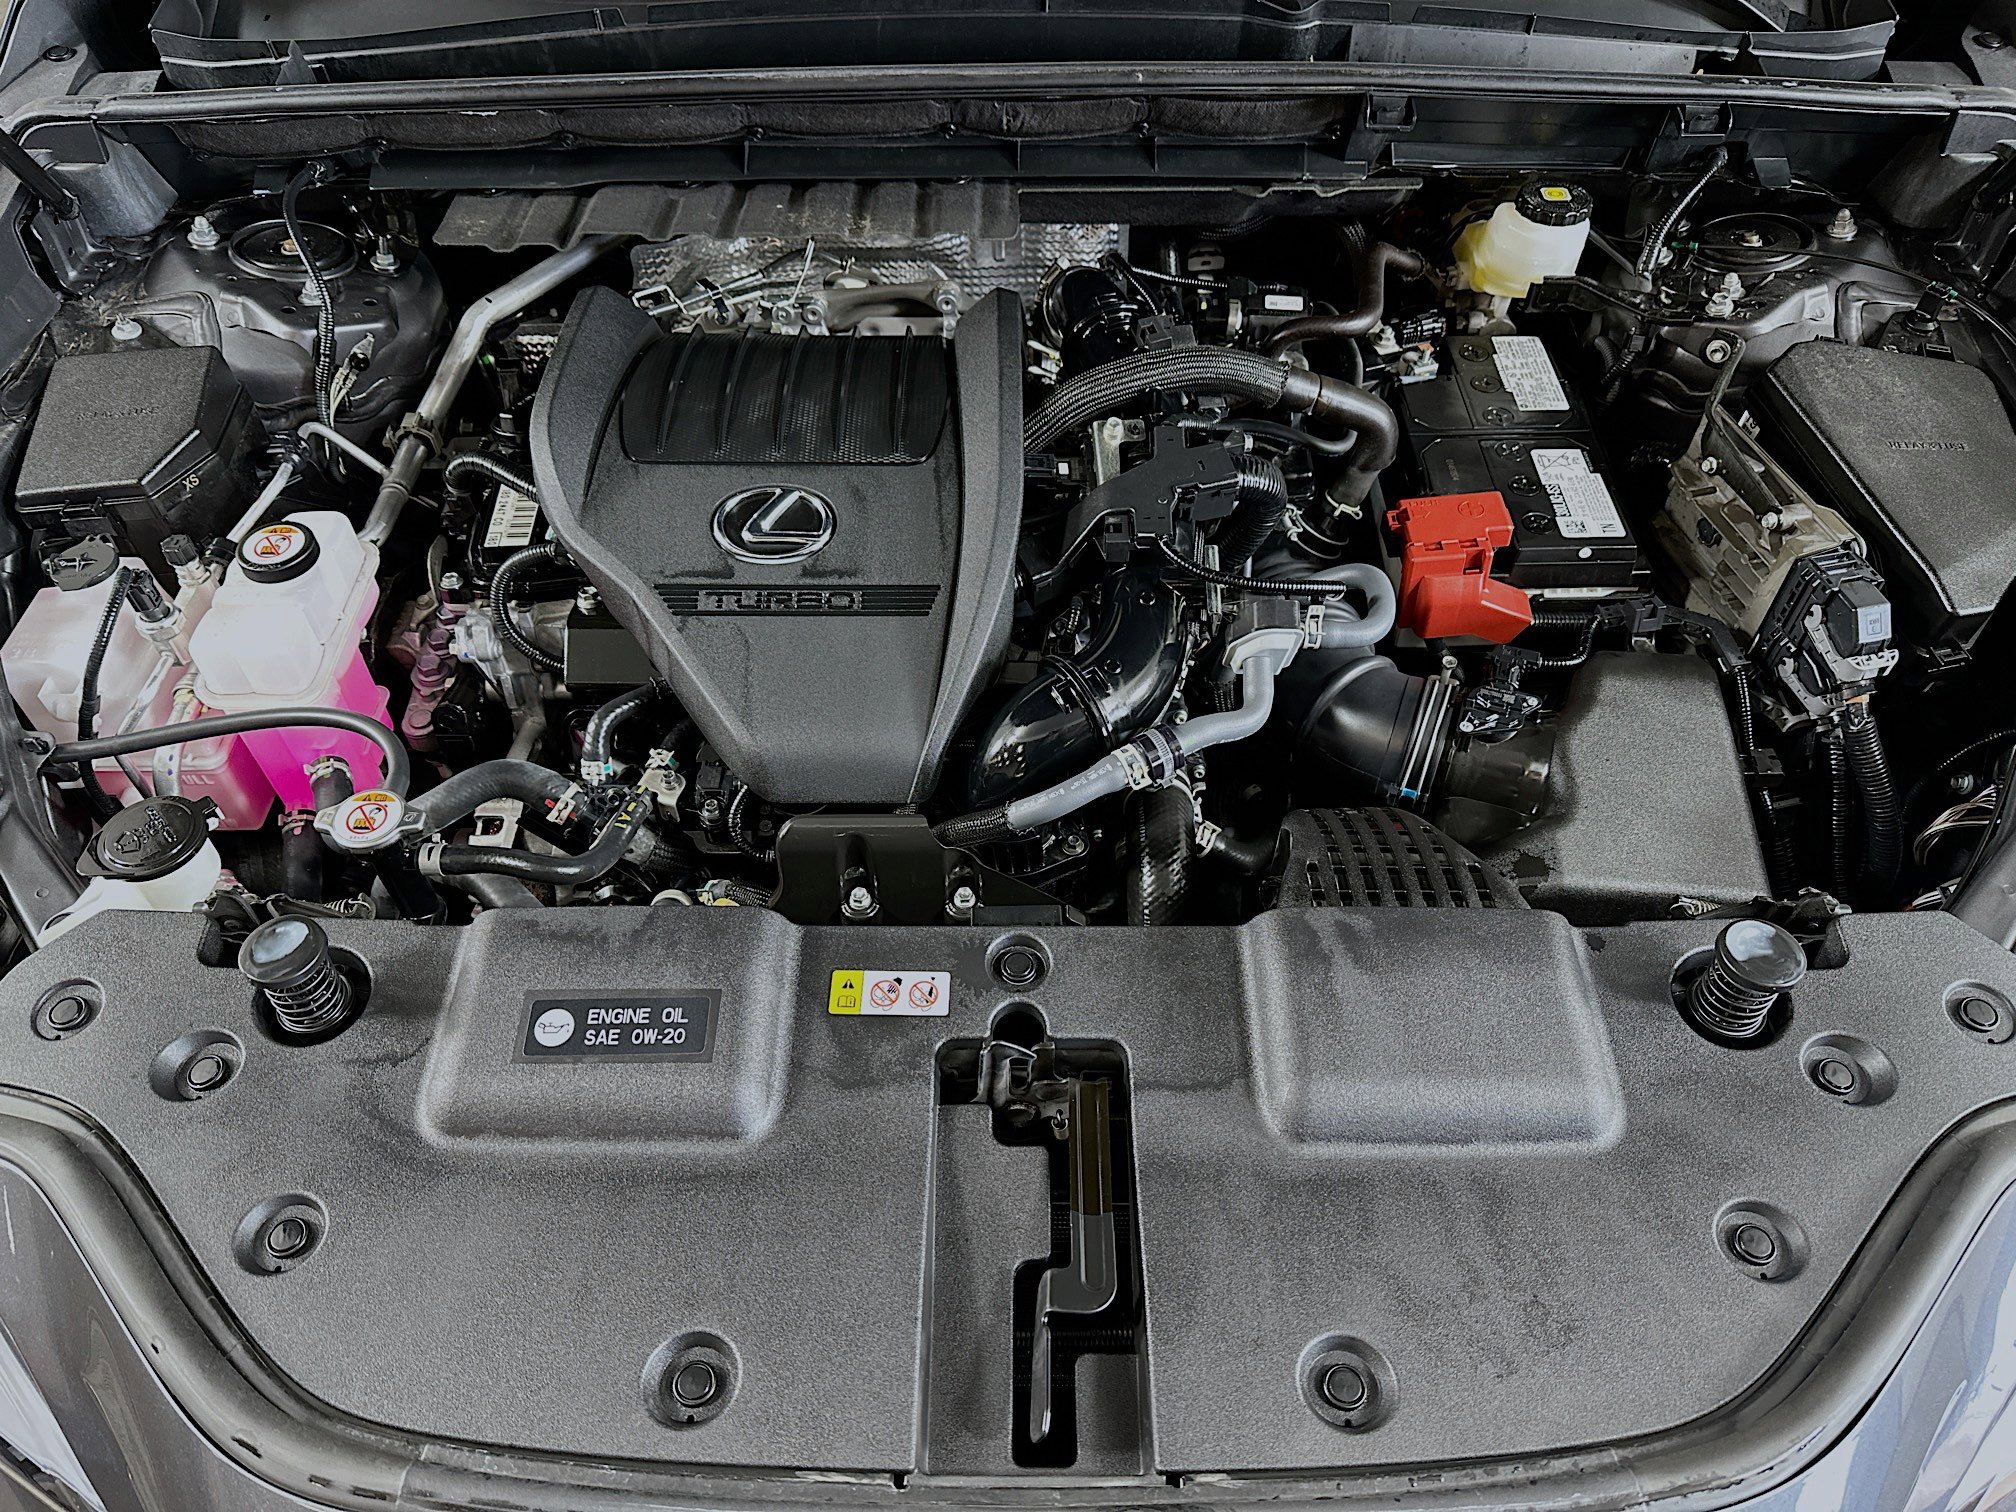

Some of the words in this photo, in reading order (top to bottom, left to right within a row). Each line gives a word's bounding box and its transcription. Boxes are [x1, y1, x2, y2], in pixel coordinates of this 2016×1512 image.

[182, 473, 200, 491] XS
[698, 588, 863, 612] TURBO
[587, 1008, 651, 1025] ENGINE
[661, 1007, 689, 1024] OIL
[583, 1029, 621, 1046] SAE
[631, 1028, 686, 1045] 0W-20
